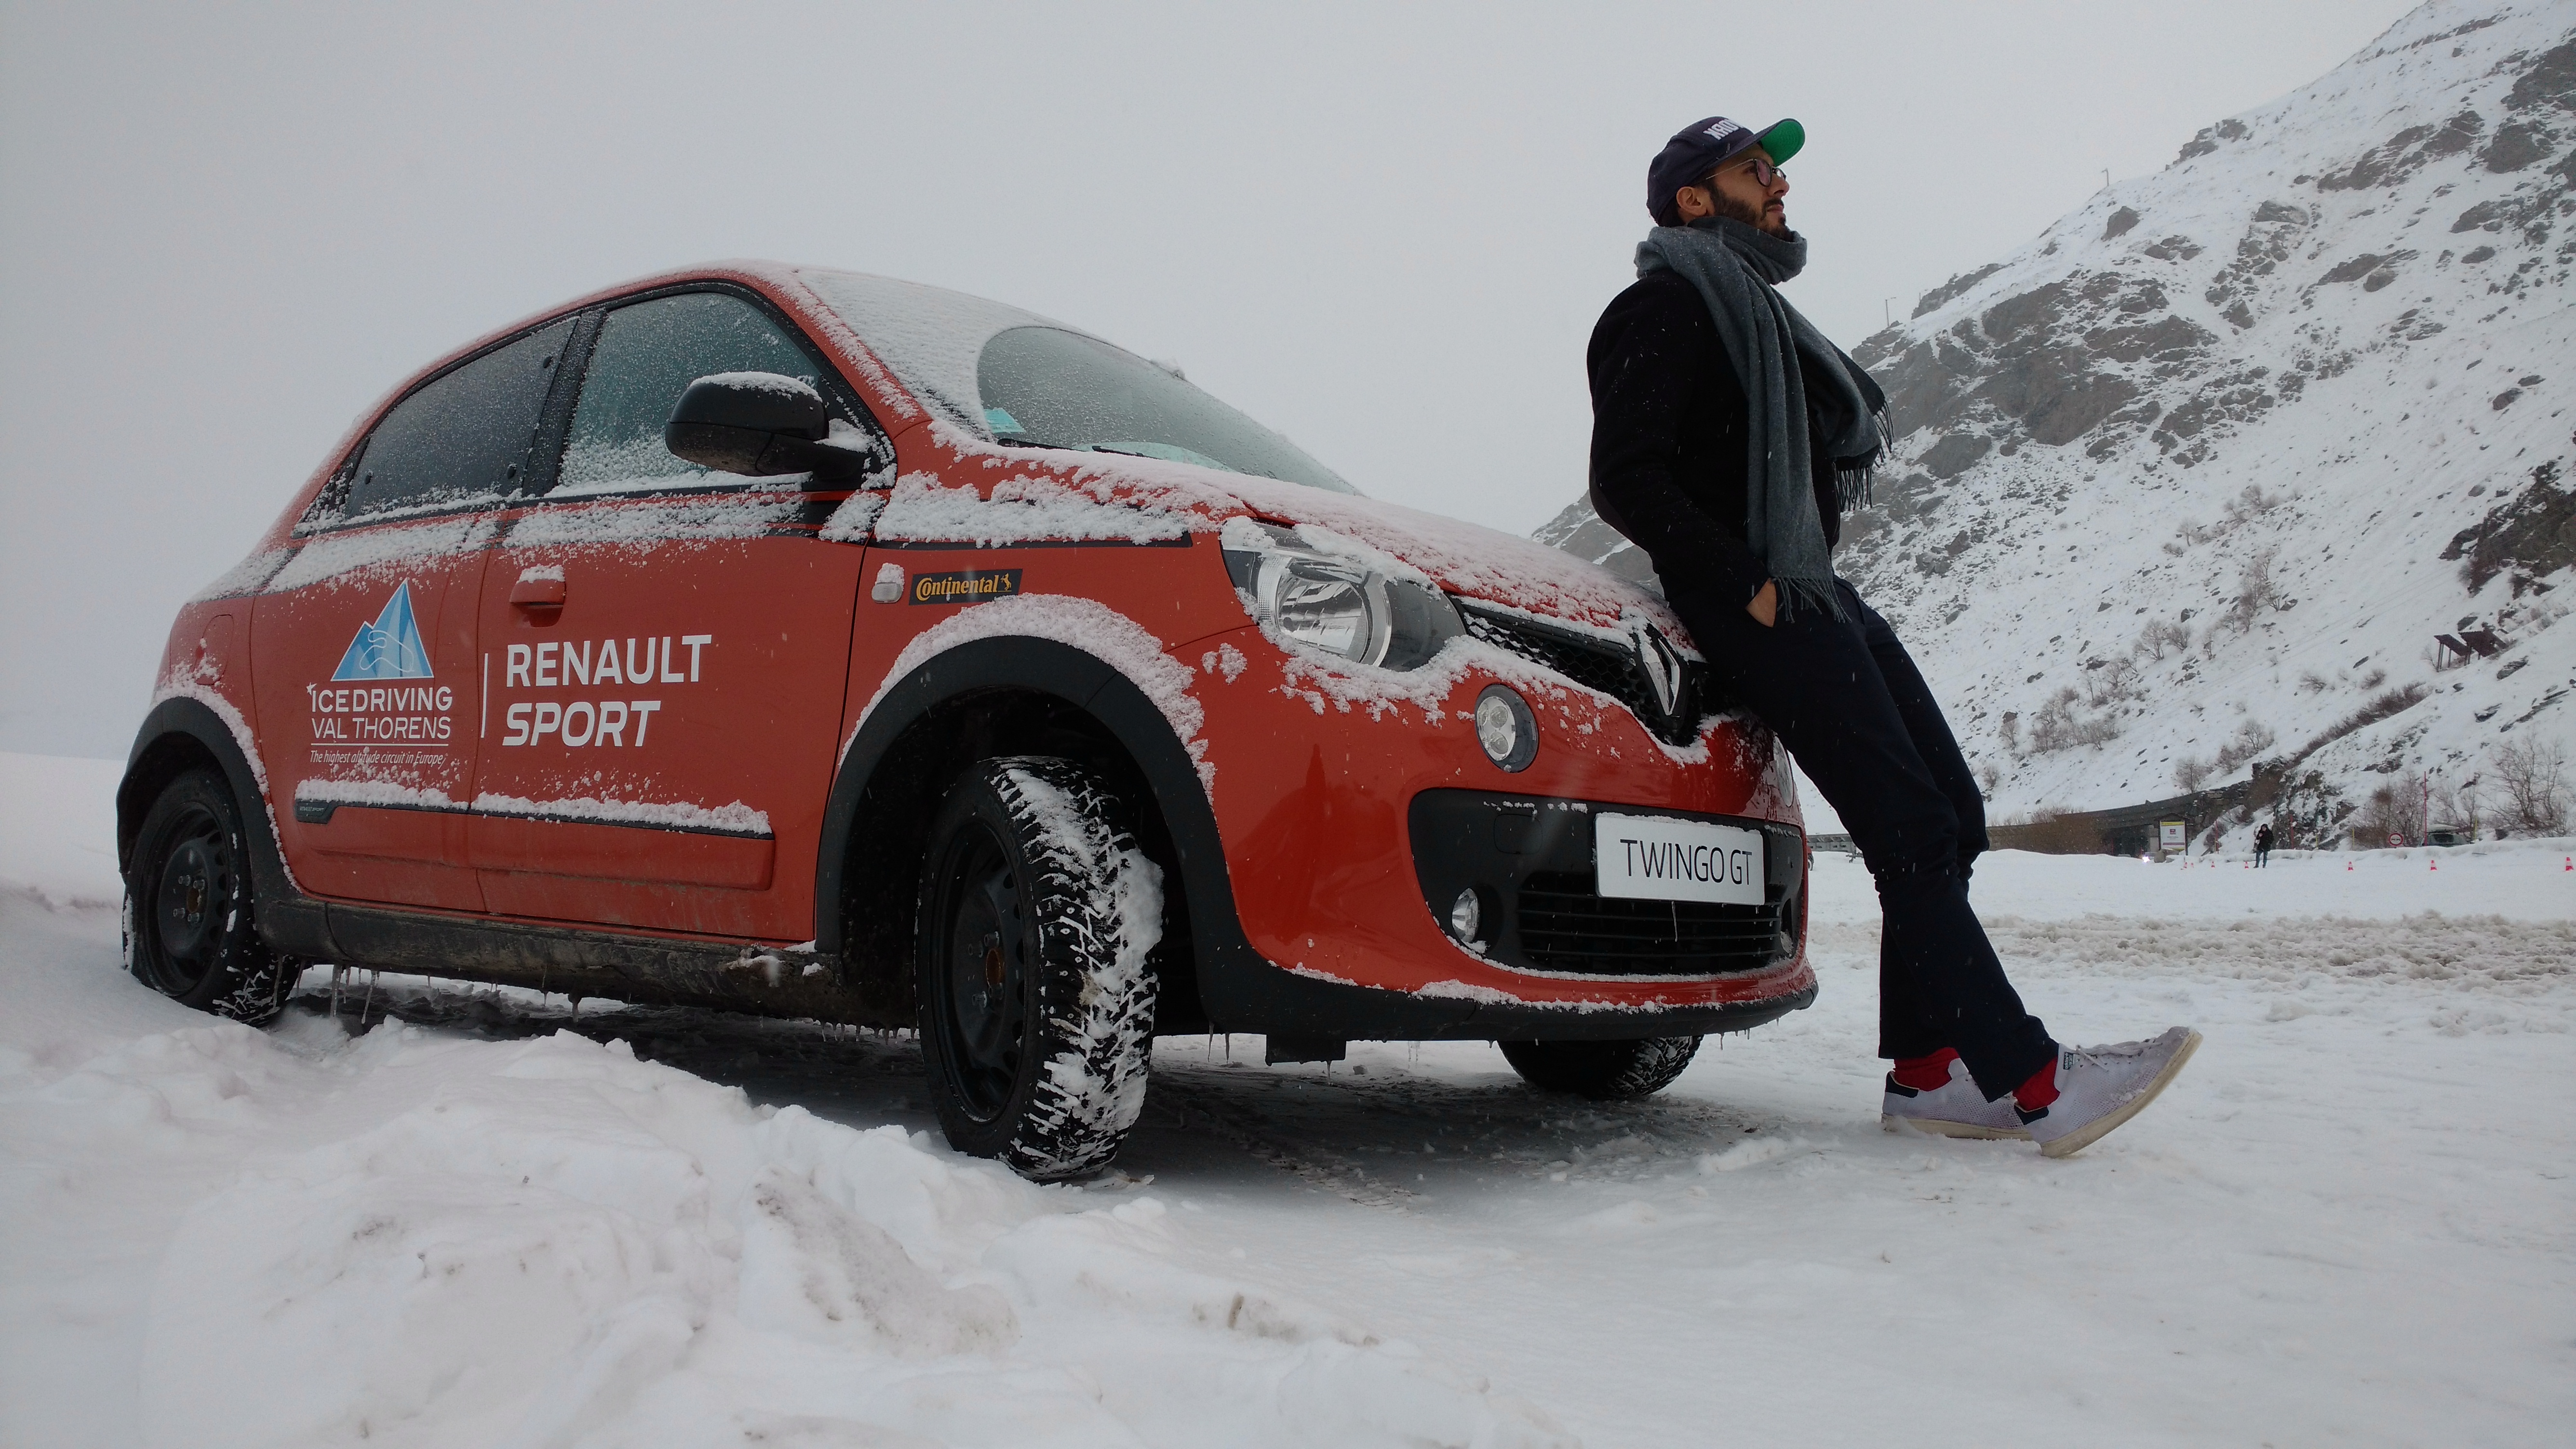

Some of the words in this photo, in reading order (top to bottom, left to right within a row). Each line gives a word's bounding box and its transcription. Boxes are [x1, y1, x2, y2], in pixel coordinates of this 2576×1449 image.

[916, 575, 999, 602] Continental
[507, 634, 712, 687] RENAULT
[311, 718, 347, 738] VAL
[352, 716, 451, 739] THORENS
[502, 700, 661, 747] SPORT
[310, 750, 322, 763] The
[323, 750, 350, 765] highest
[351, 750, 379, 763] altitude
[381, 751, 407, 764] circuit
[405, 751, 414, 764] in
[1620, 839, 1724, 883] TWINGO
[1730, 849, 1753, 885] GT
